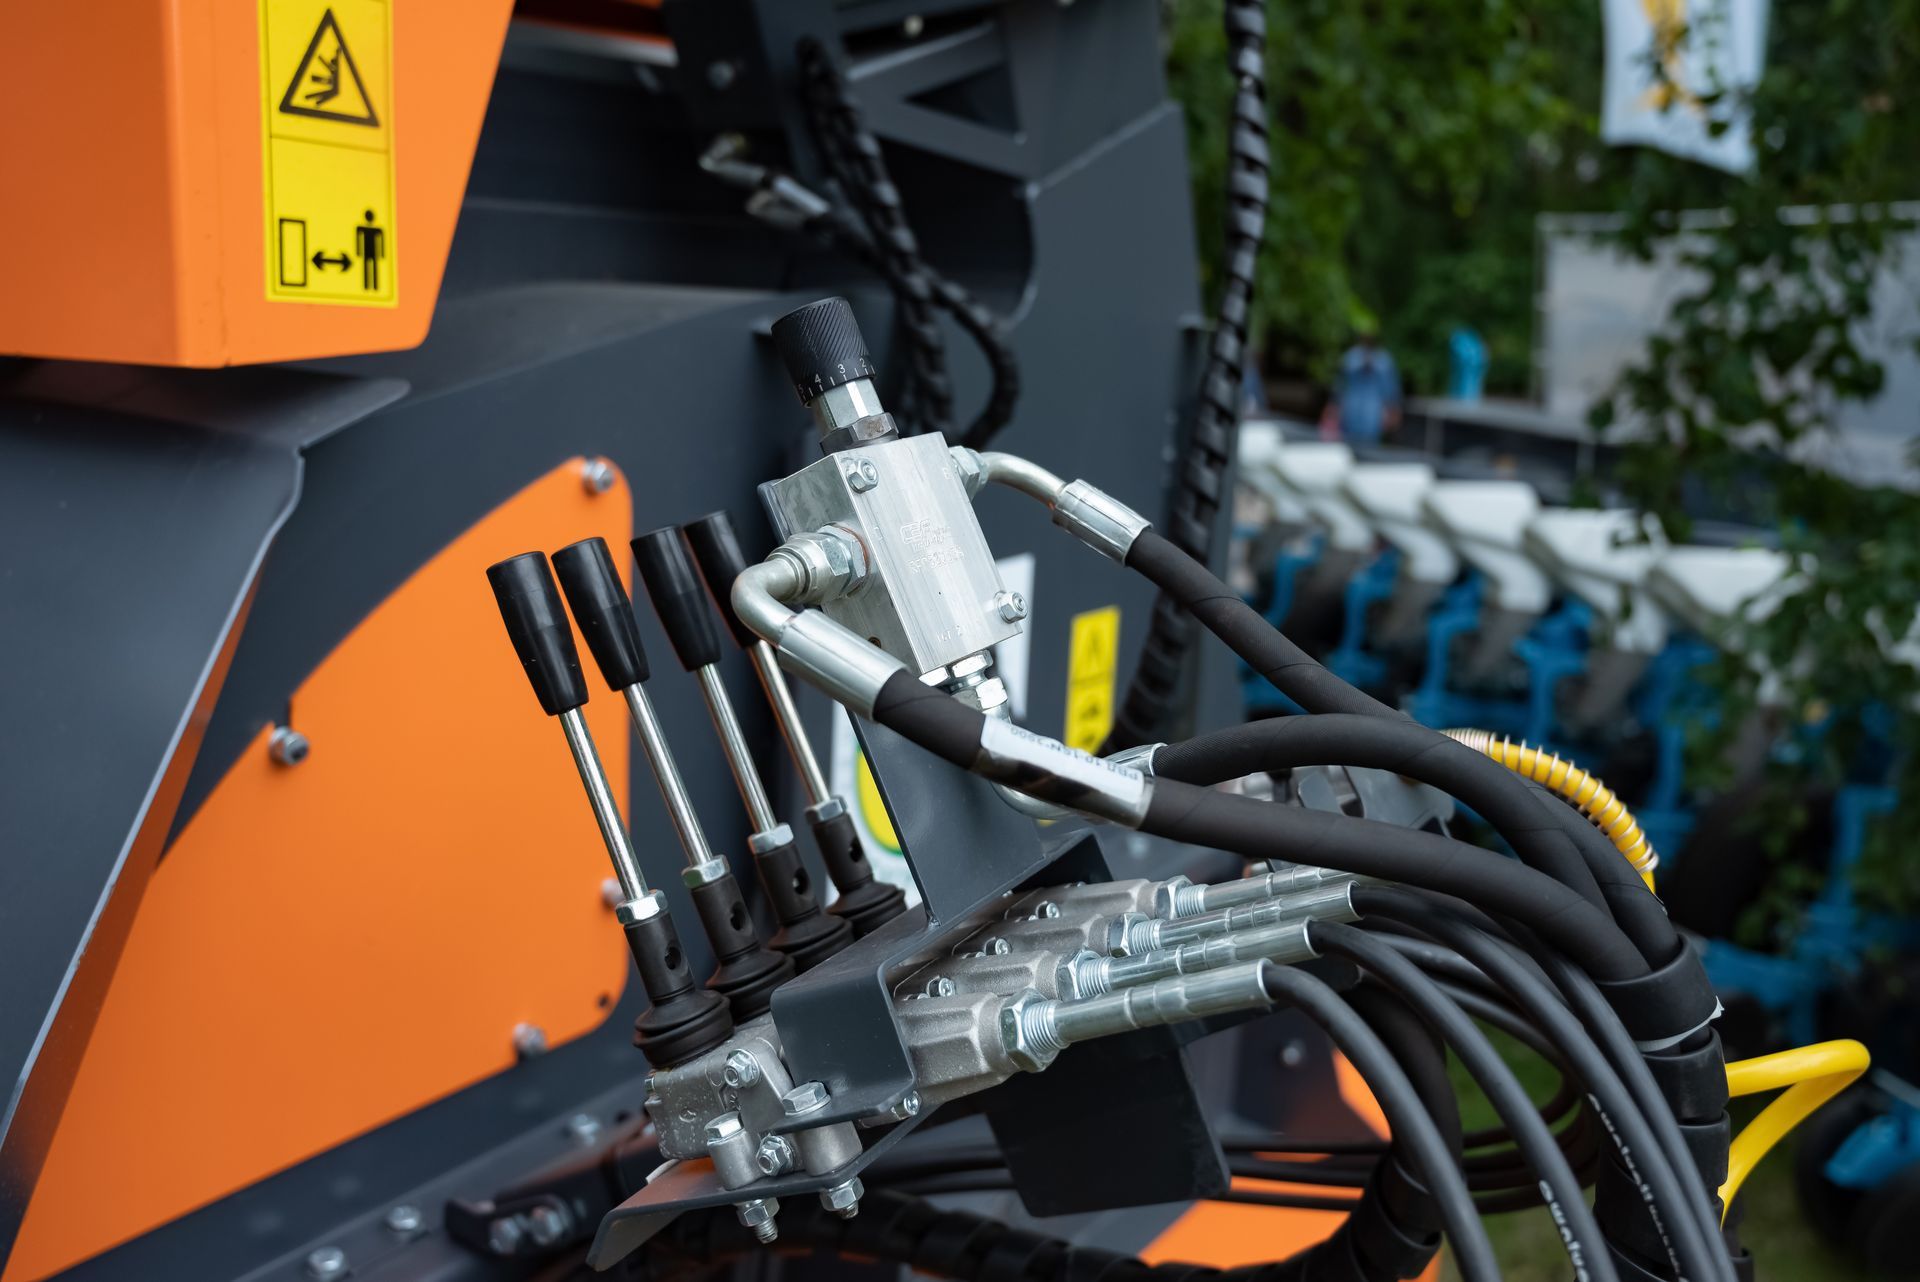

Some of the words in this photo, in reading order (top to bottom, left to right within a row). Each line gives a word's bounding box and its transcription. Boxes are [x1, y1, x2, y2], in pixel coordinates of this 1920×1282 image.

[814, 373, 822, 384] 4
[837, 363, 846, 374] 3
[859, 357, 867, 368] 2
